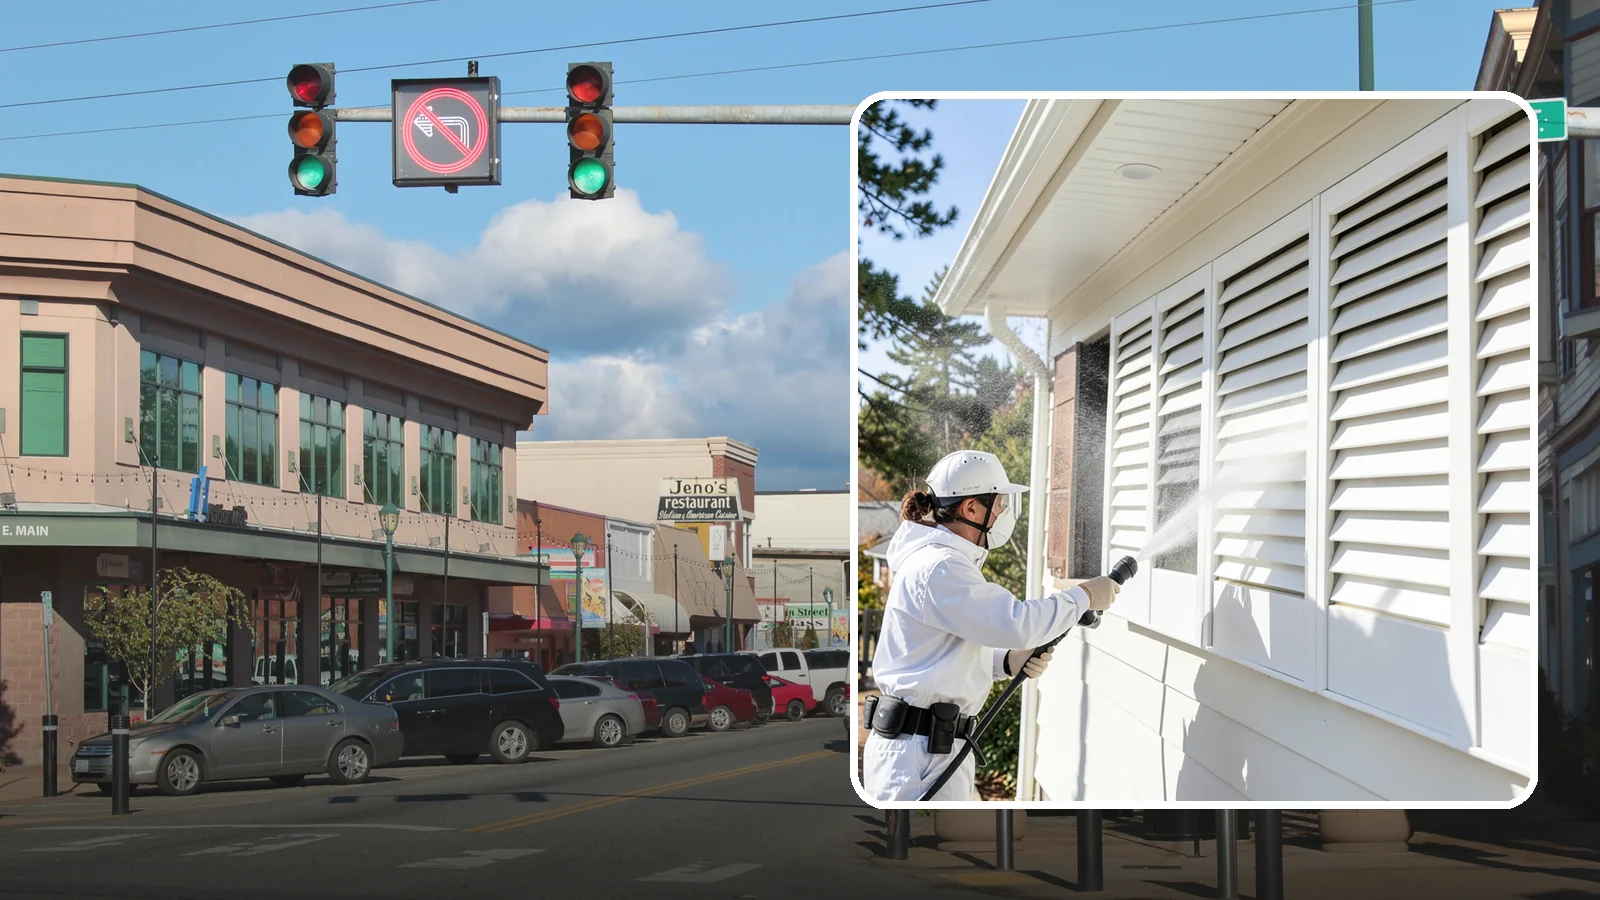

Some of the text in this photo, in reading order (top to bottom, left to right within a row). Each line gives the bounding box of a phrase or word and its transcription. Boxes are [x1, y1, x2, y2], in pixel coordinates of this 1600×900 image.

[670, 480, 727, 494] Jeno's
[665, 497, 731, 509] restaurant
[686, 510, 714, 519] American
[715, 510, 737, 519] Cuisine
[2, 525, 49, 536] E. MAIN
[797, 607, 828, 617] Street
